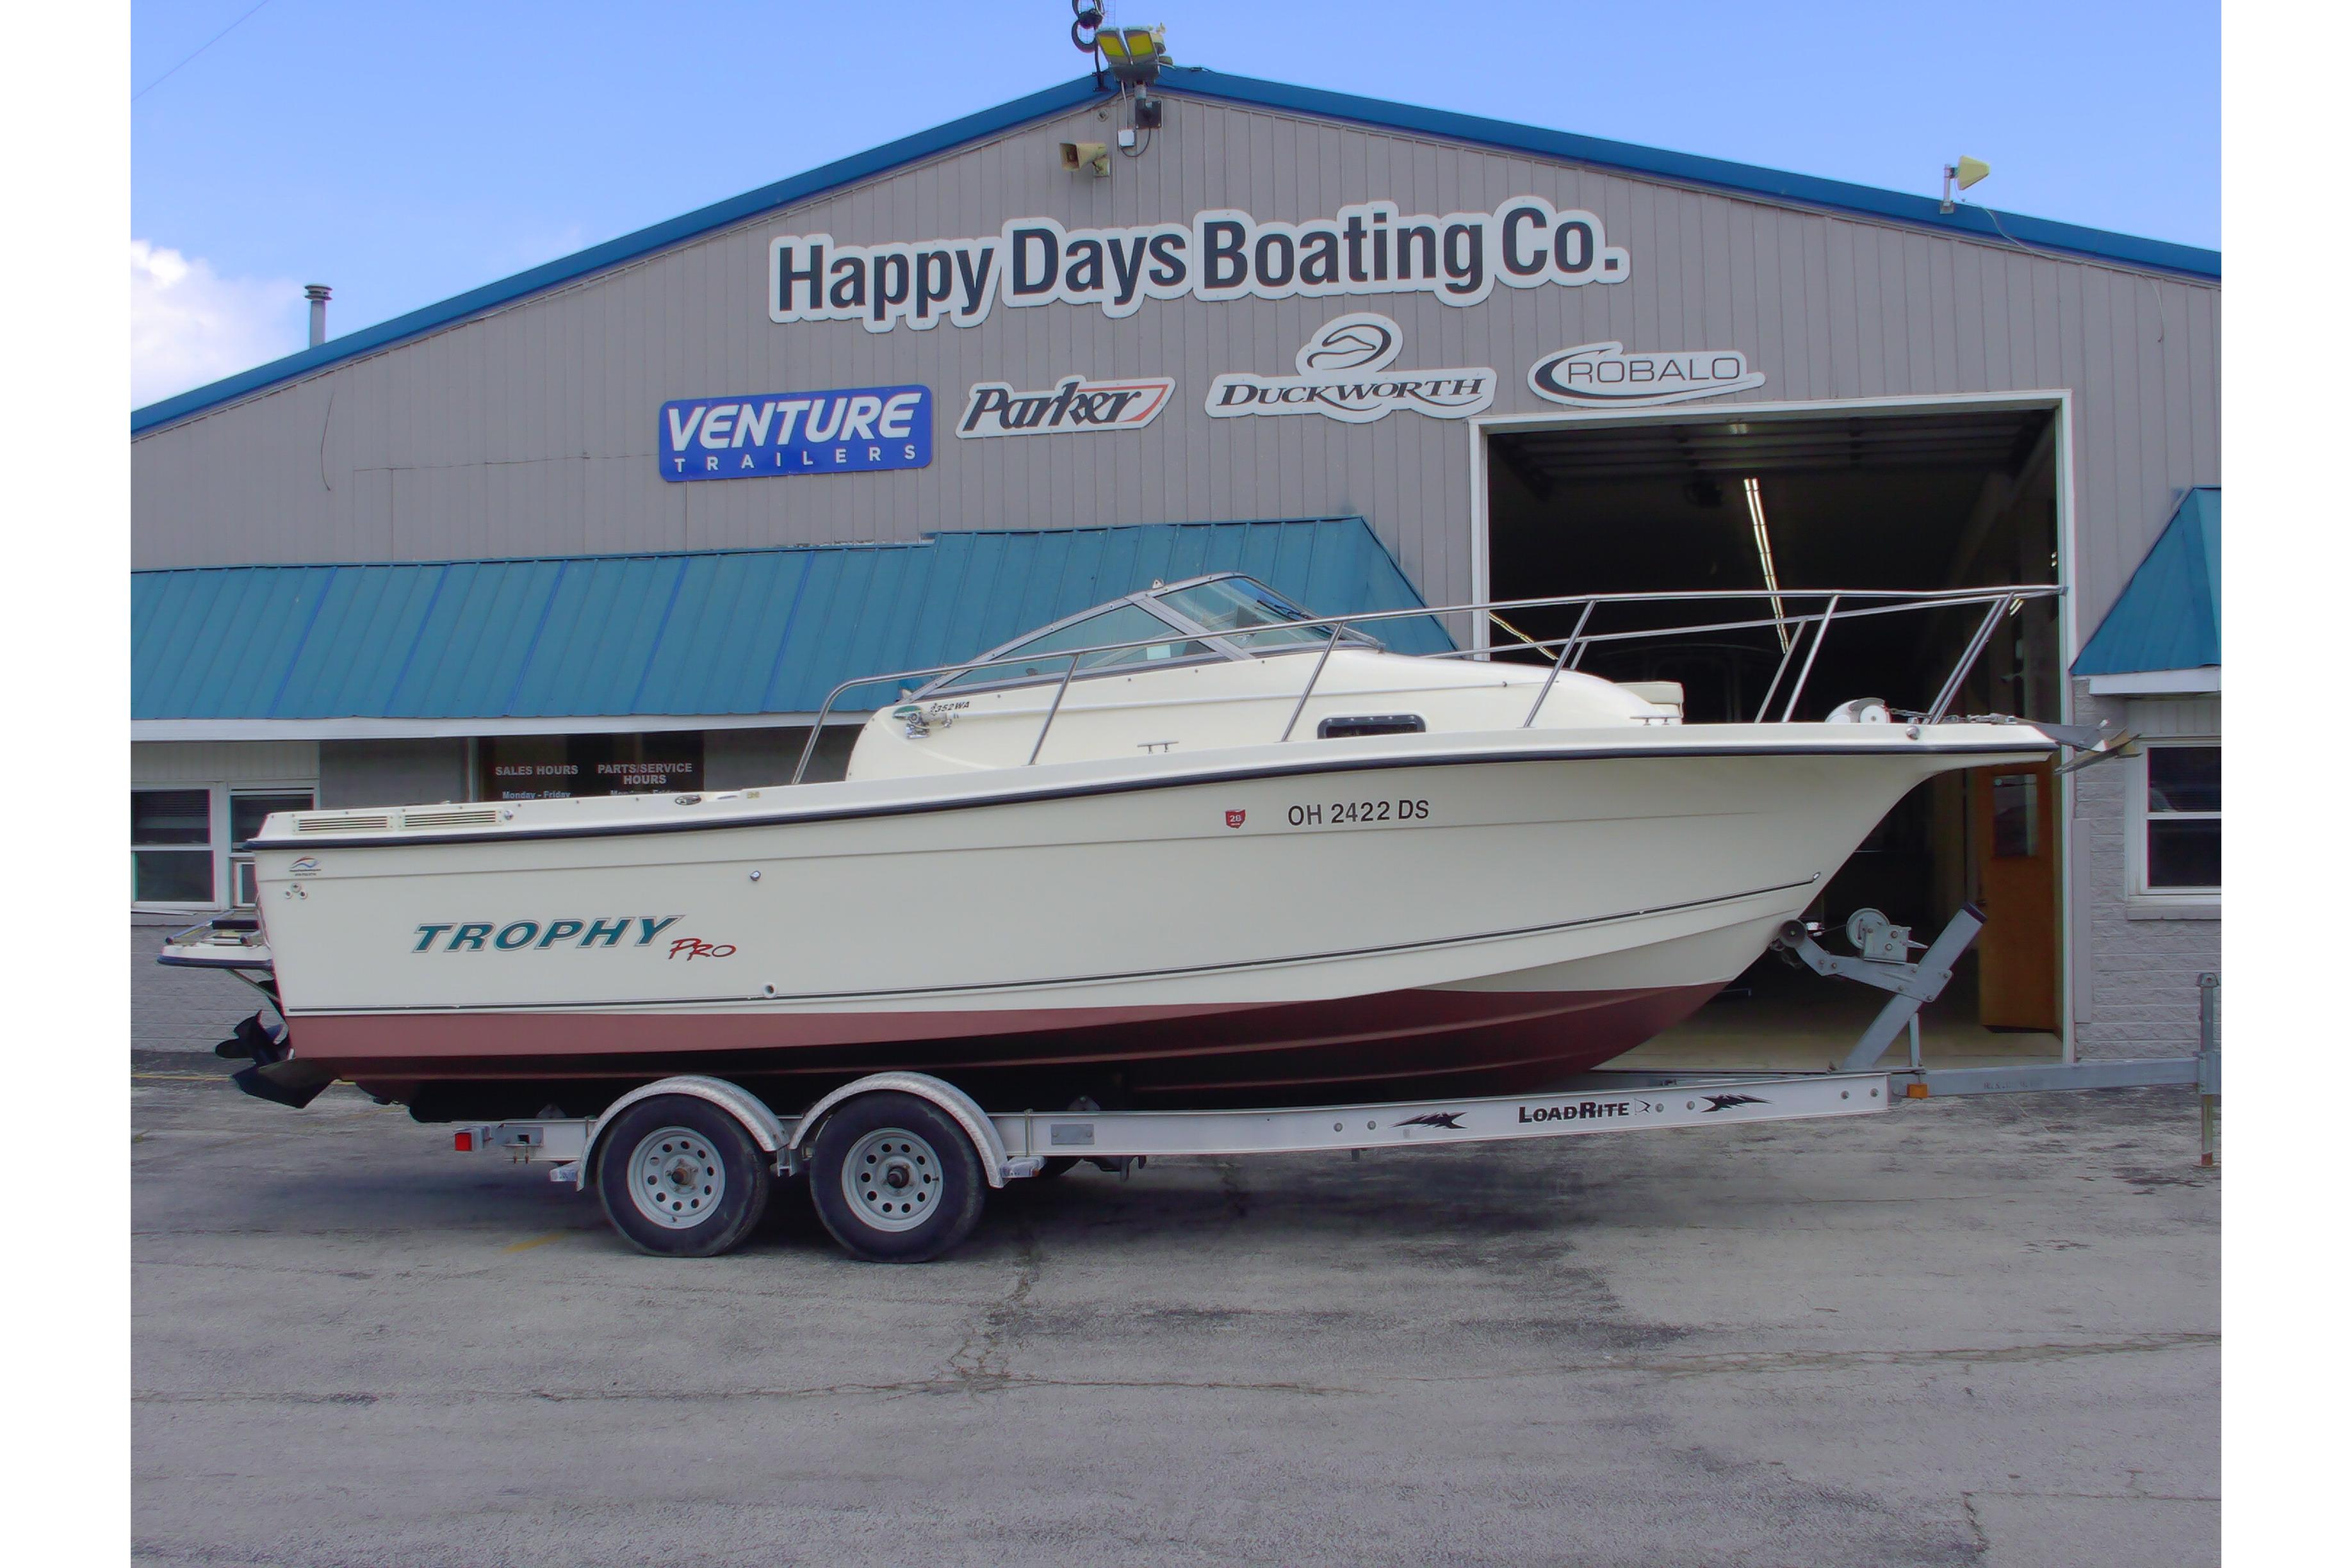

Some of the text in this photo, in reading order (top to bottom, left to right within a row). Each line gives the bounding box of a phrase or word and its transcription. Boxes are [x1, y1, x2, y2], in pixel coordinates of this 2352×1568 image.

[778, 206, 1619, 322] Happy Days Boating Co.
[1567, 354, 1741, 384] ROBALO
[962, 381, 1142, 432] Parker
[1218, 377, 1487, 412] DUCKWORTH
[667, 392, 922, 452] VENTURE
[674, 445, 917, 473] TRAILERS
[495, 765, 579, 776] SALES HOURS
[598, 763, 692, 774] PARTS/SERVICE
[623, 774, 667, 785] HOURS
[502, 791, 535, 799] Monday
[543, 790, 571, 799] Friday
[1287, 799, 1430, 826] OH 2422 DS
[411, 914, 687, 954] TROPHY
